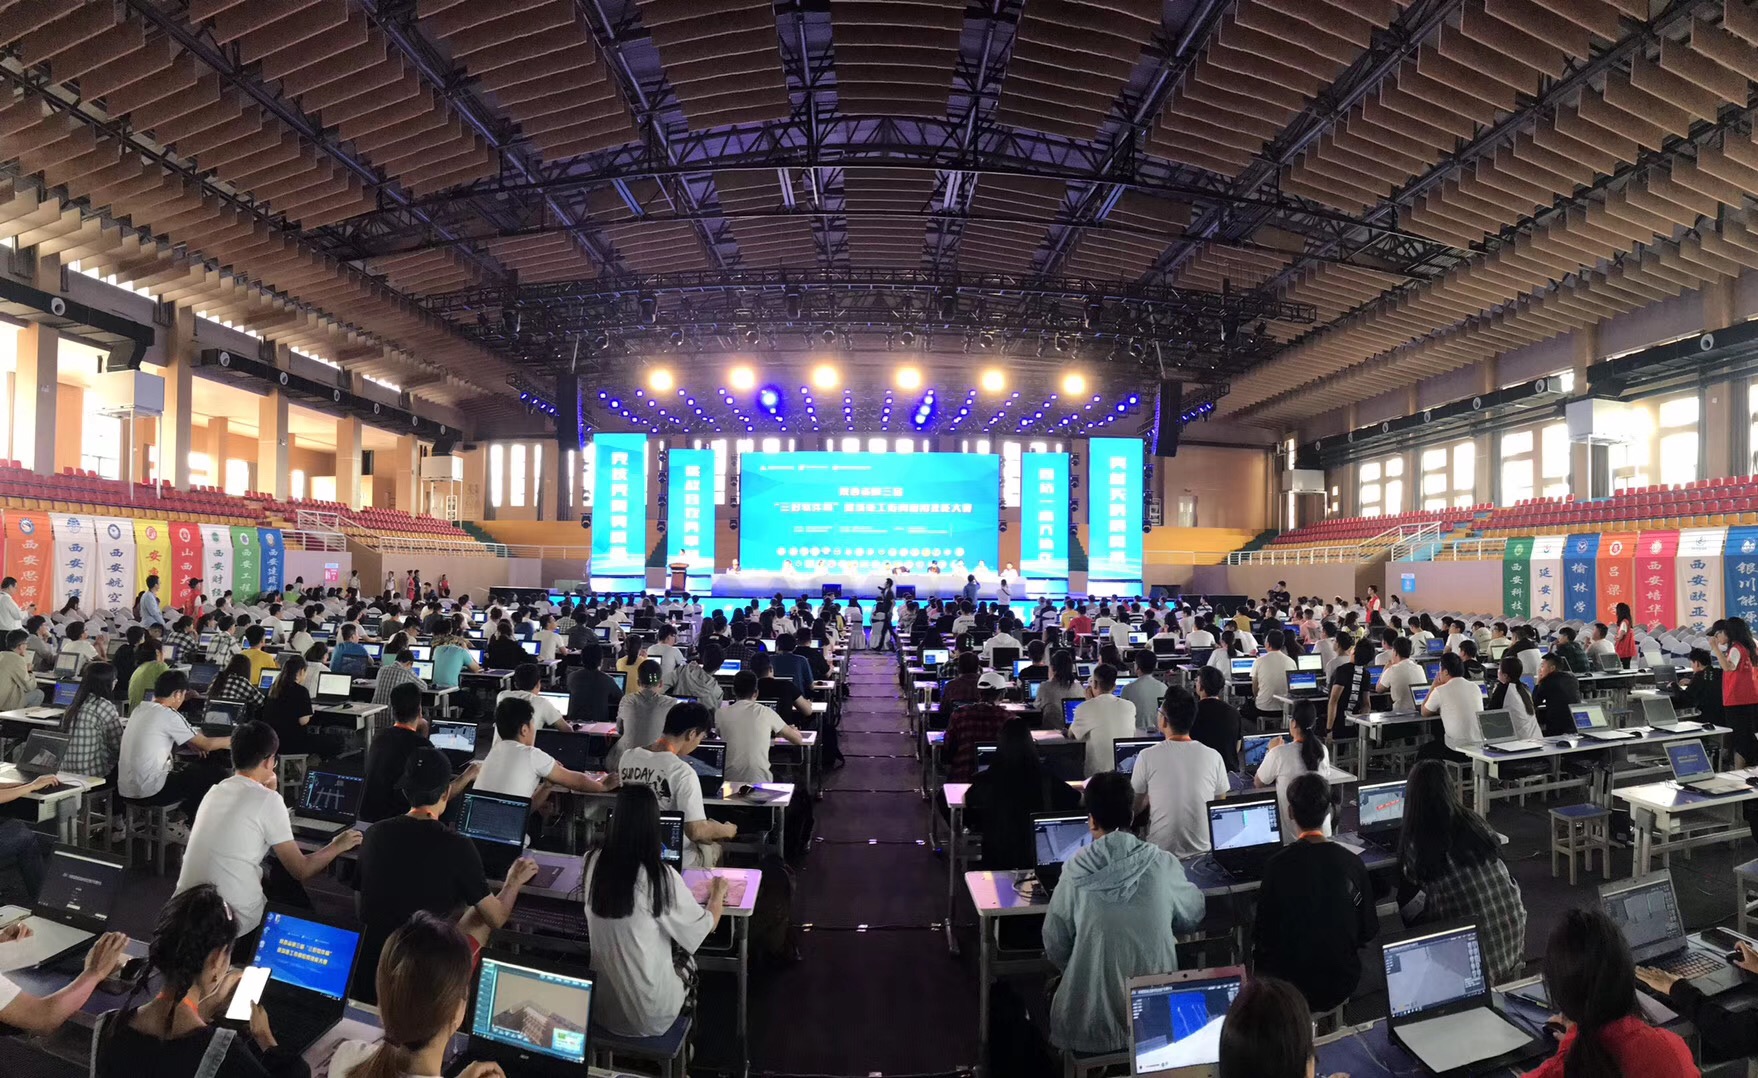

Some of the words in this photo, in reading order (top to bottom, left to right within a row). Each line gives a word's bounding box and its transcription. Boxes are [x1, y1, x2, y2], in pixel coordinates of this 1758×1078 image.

[211, 549, 224, 597] 西安财经
[1538, 567, 1553, 613] 延安大
[1570, 562, 1589, 613] 榆林学
